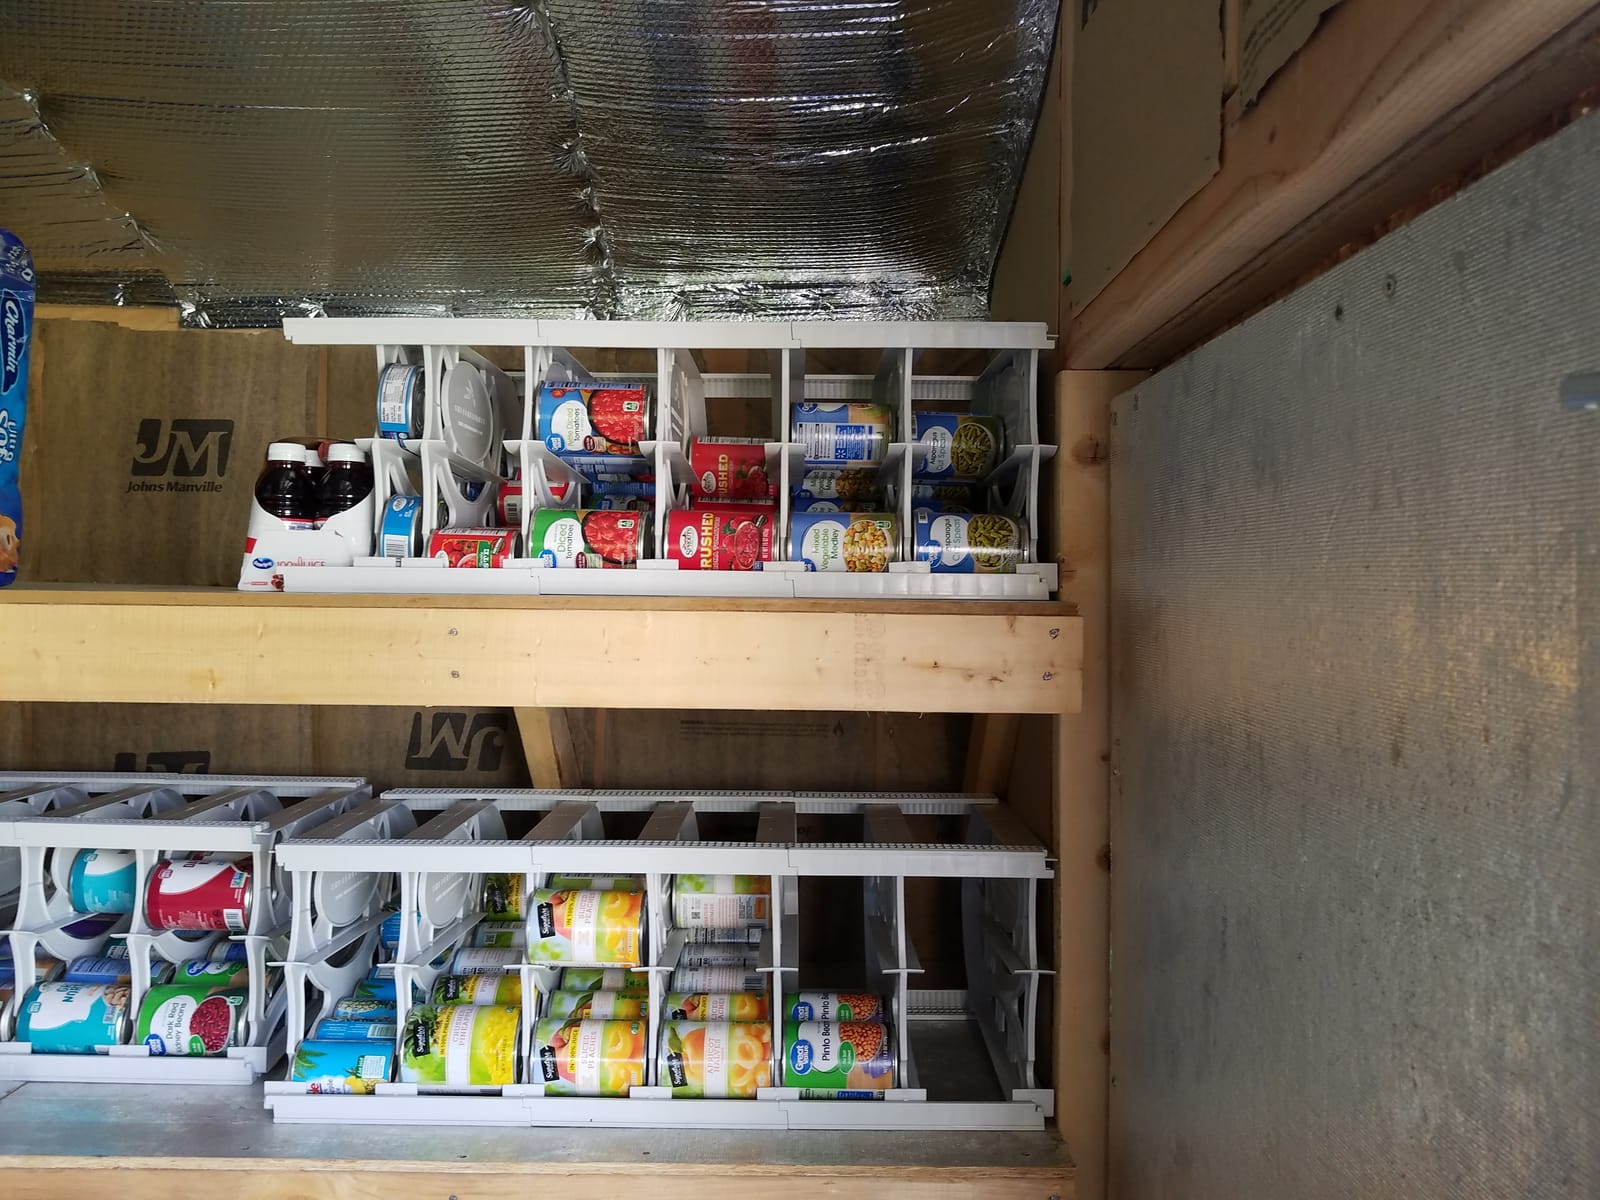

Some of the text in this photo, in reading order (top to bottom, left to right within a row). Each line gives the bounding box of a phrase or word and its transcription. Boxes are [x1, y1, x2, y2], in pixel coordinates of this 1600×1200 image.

[5, 299, 20, 374] Charmin
[131, 418, 235, 477] JM
[125, 481, 223, 494] Johns Manville
[718, 454, 729, 494] USHED
[557, 523, 567, 552] Diced
[566, 524, 575, 560] Tomatoes
[700, 513, 714, 569] RUSHED
[811, 529, 820, 554] Mixed
[821, 528, 831, 570] Vegetable
[830, 528, 840, 559] Medley
[166, 1002, 179, 1040] Dark Red
[174, 1003, 187, 1028] Beans
[821, 1001, 829, 1020] Pinto
[795, 1045, 804, 1070] Great
[821, 1038, 831, 1061] Pinto
